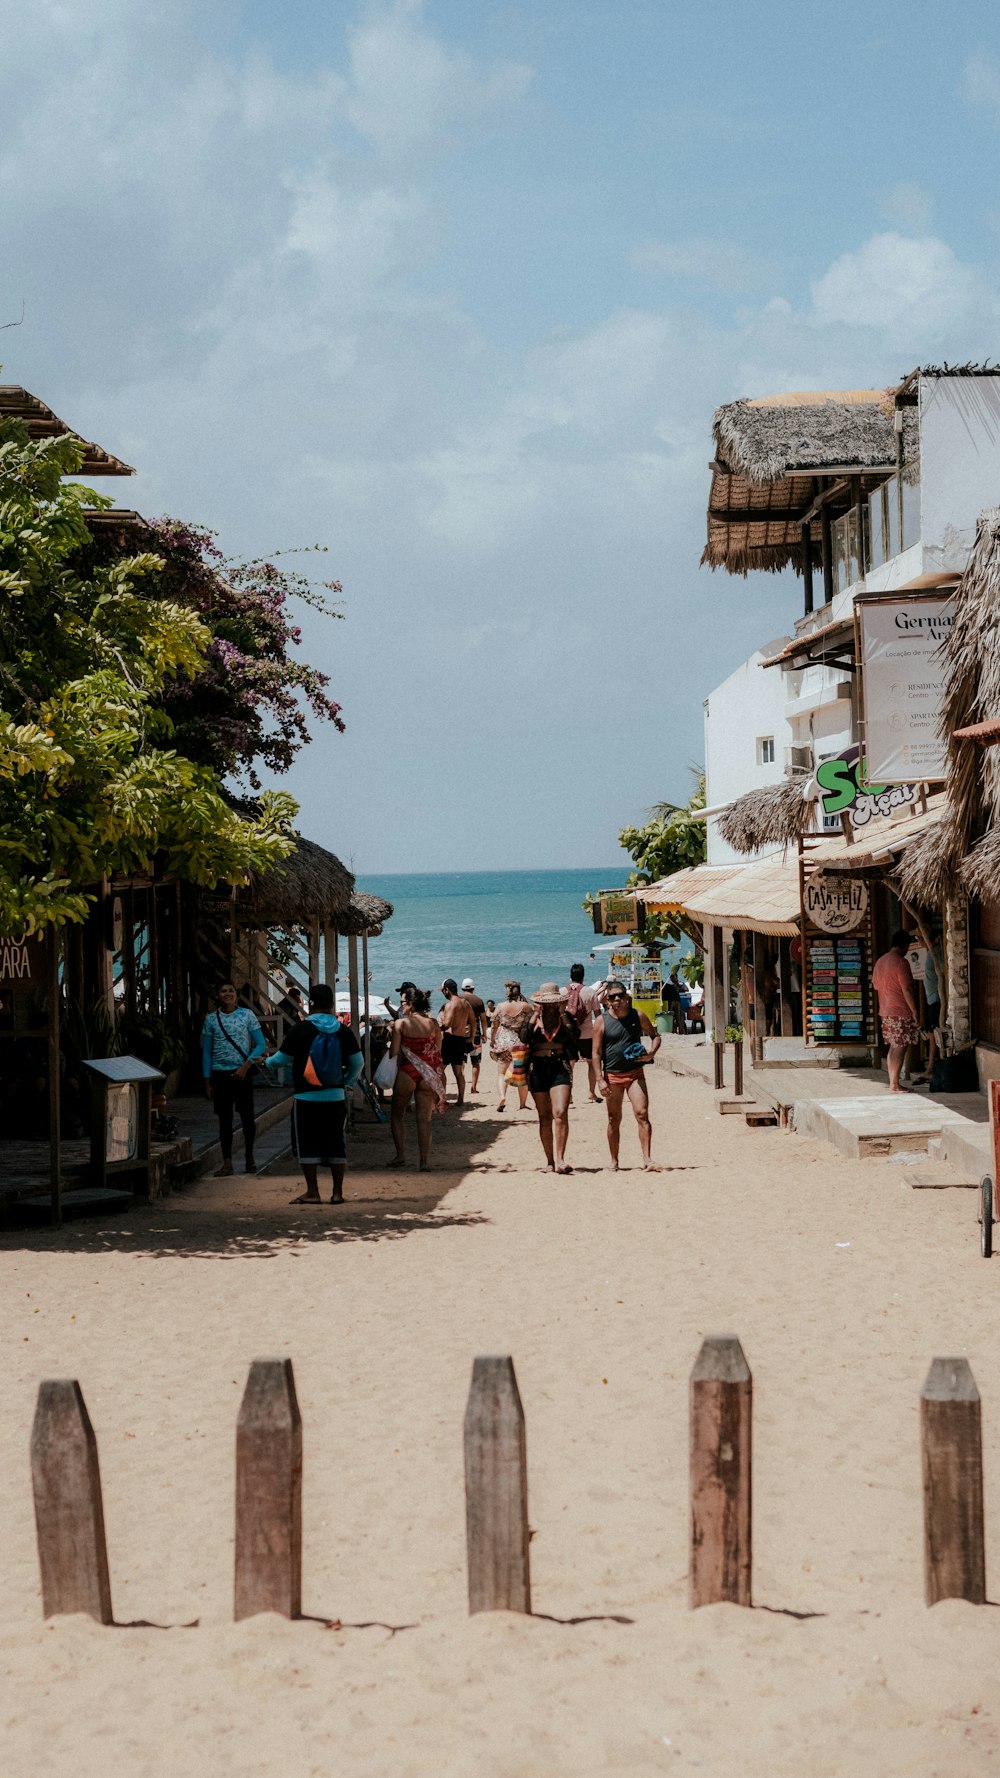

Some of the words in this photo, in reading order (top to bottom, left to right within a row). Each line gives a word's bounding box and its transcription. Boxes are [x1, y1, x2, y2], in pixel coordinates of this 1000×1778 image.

[895, 612, 954, 630] Germa
[604, 899, 635, 912] JERI
[808, 885, 832, 911] CASA
[606, 911, 635, 923] ARTE
[824, 910, 848, 926] Jeri
[0, 945, 31, 980] ARA
